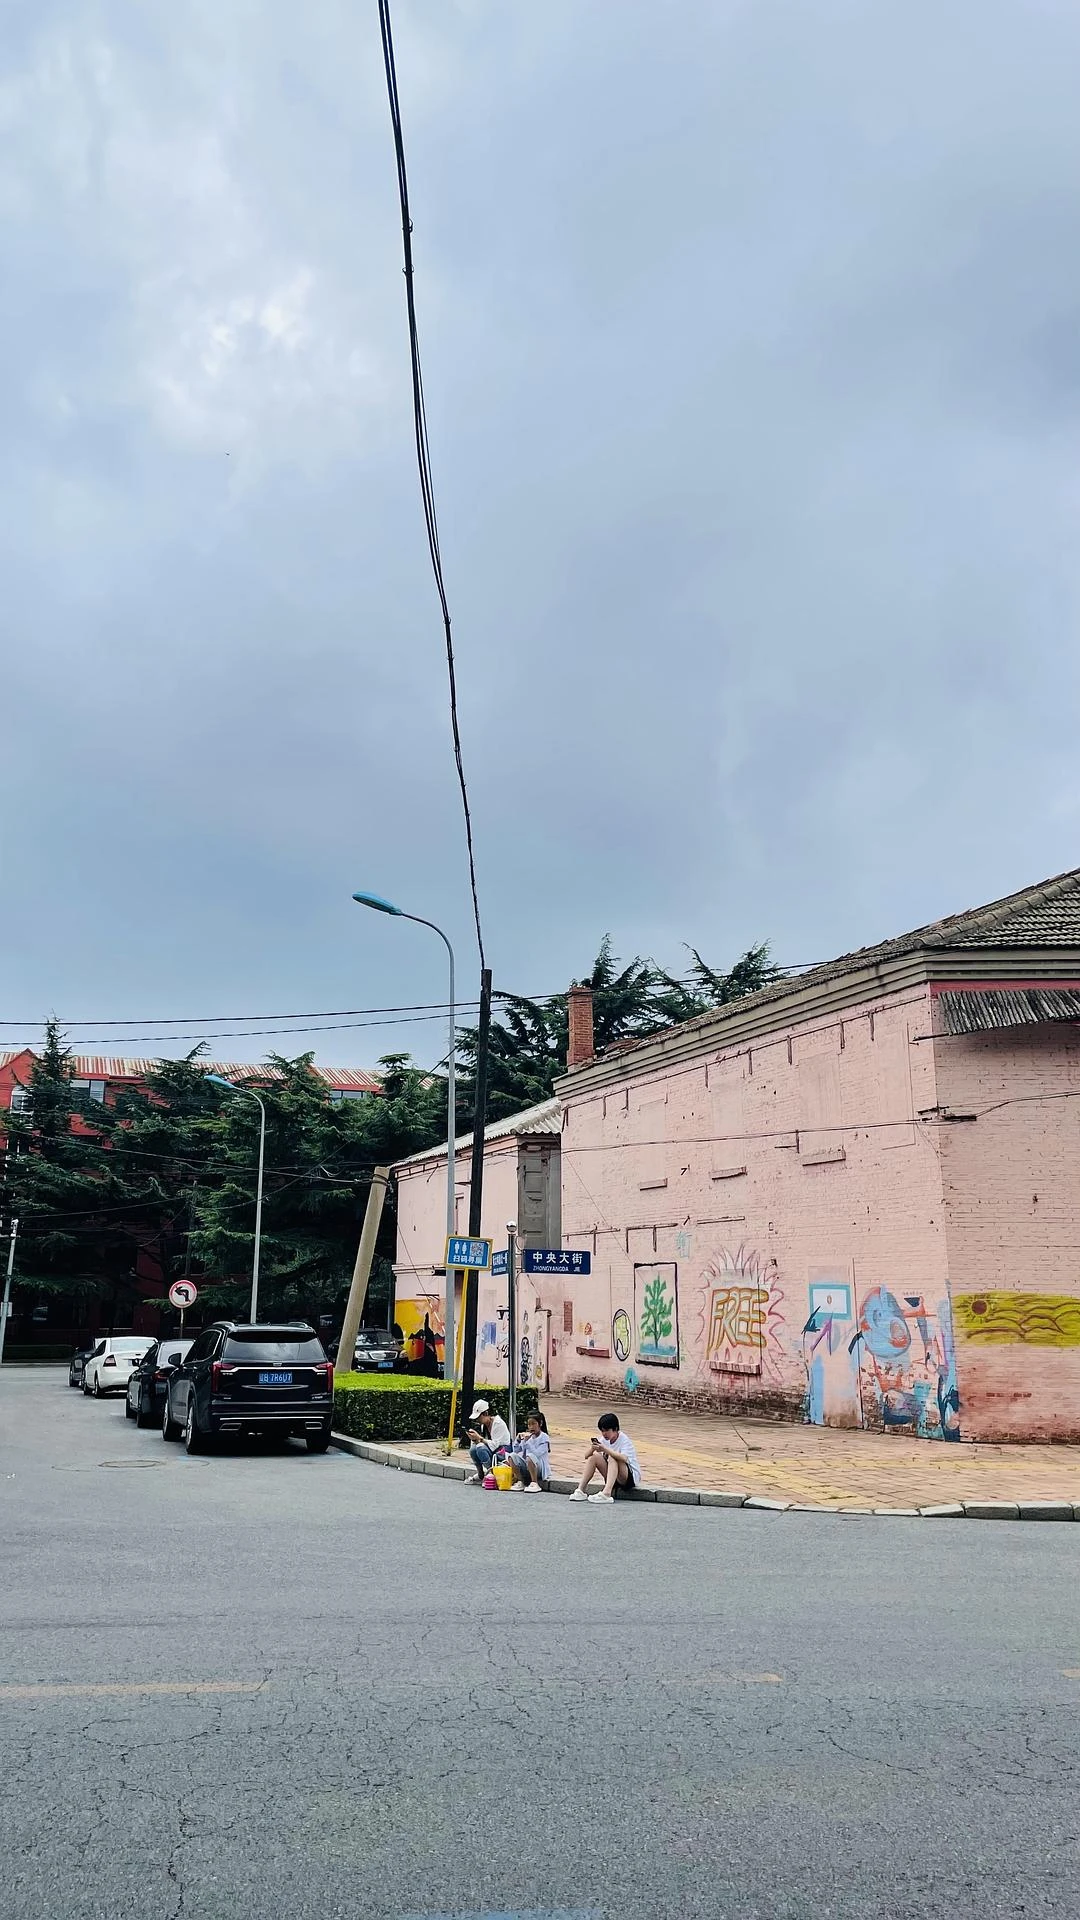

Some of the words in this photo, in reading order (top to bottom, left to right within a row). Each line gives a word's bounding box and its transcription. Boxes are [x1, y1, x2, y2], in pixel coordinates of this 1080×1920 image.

[532, 1251, 583, 1265] 中央大街
[706, 1287, 769, 1360] FREE
